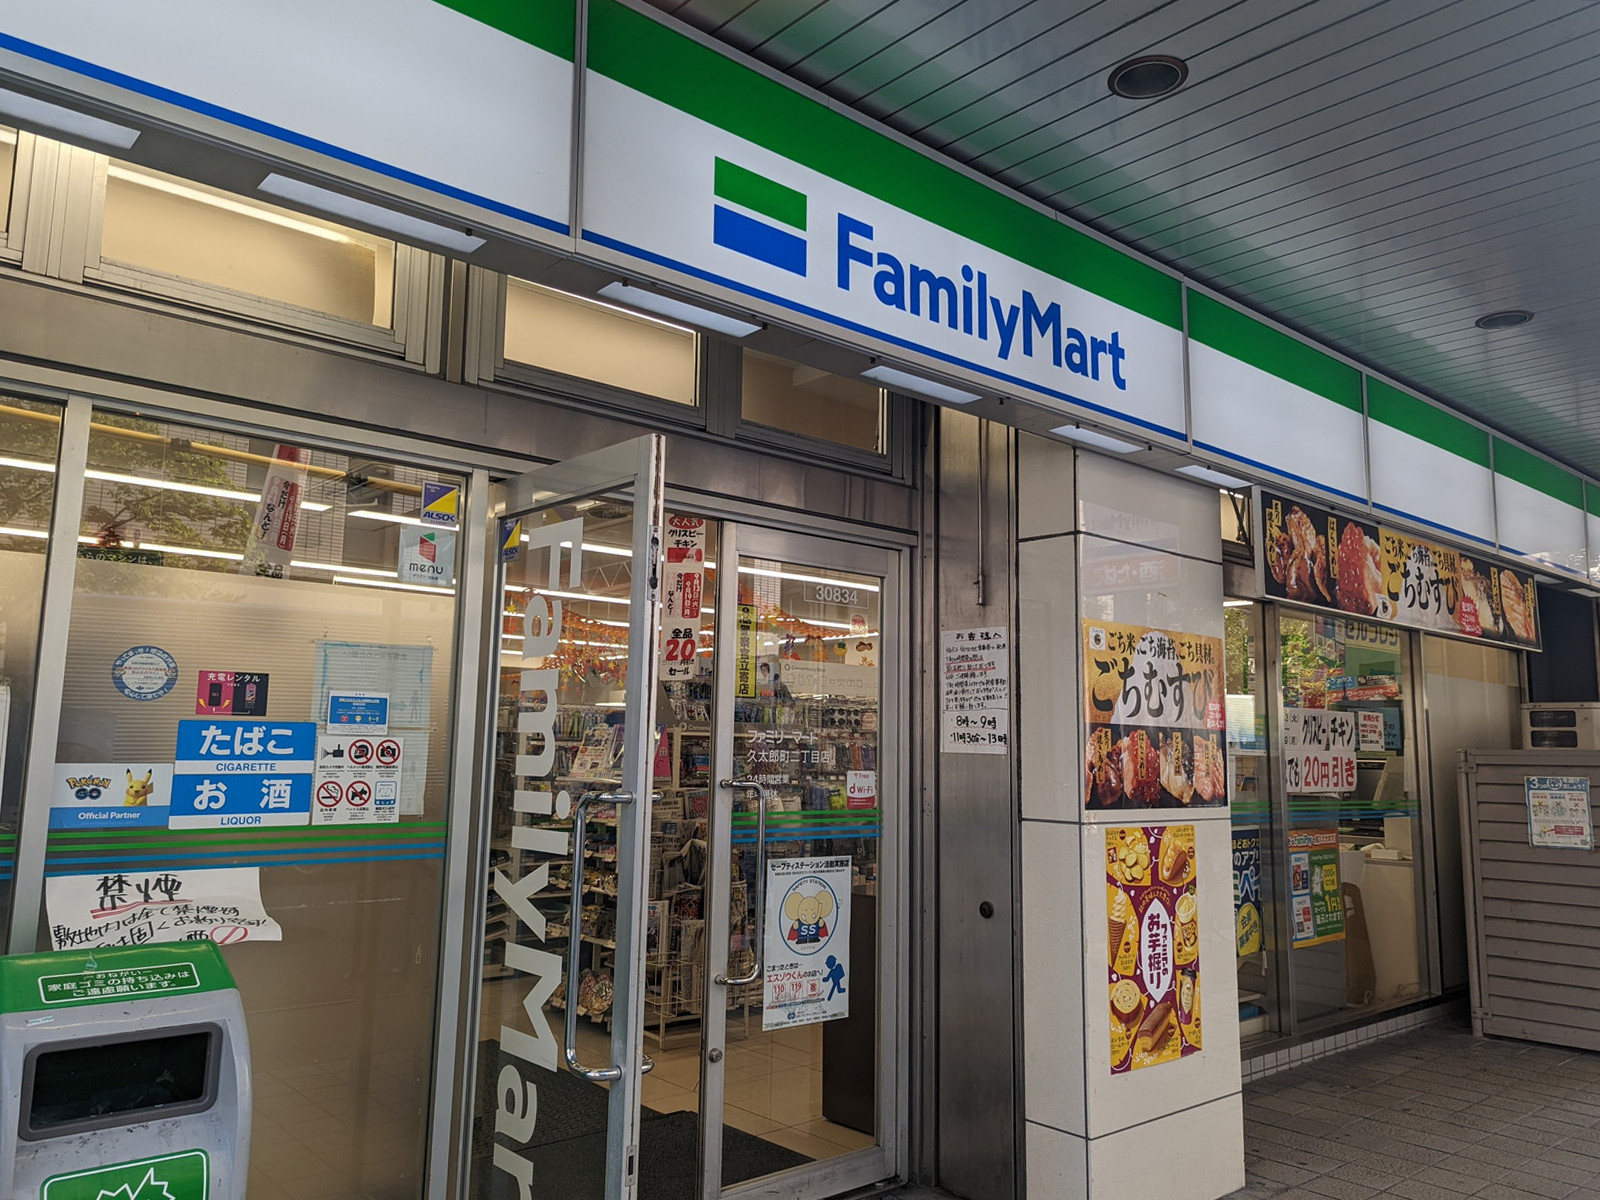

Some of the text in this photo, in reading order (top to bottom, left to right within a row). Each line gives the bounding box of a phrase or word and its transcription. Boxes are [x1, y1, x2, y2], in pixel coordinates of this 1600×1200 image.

[837, 212, 1127, 391] FamilyMart
[423, 511, 455, 522] ALSOK
[668, 529, 704, 538] クリスピー
[674, 540, 698, 548] チキン
[409, 563, 444, 574] menu
[1387, 560, 1459, 616] ごちむすび
[815, 584, 859, 605] 30834
[672, 628, 693, 639] 全品
[665, 639, 696, 661] 20
[207, 672, 261, 683] 充電レンタル
[668, 667, 690, 676] セール
[1092, 657, 1214, 722] ごちむすび
[1302, 715, 1353, 747] クリスピーチキン
[199, 725, 294, 756] たばこ
[747, 730, 819, 745] ファミリーマート
[747, 749, 831, 763] 久太郎町二丁目店
[216, 762, 277, 772] CIGARETTE
[1304, 756, 1355, 788] 20円引き
[66, 774, 112, 790] Pokémon
[746, 774, 790, 785] 24時間営業
[75, 788, 102, 801] GO
[857, 785, 873, 794] Wi-Fi
[78, 811, 141, 821] Official Partner
[220, 815, 262, 826] LIQUOR
[809, 879, 827, 890] STATION
[96, 874, 182, 911] 禁煙
[800, 925, 817, 935] SS
[47, 970, 191, 992] 家庭ゴミの持ち込みは
[73, 981, 177, 997] ご遠慮願います。
[773, 982, 802, 993] 110 119
